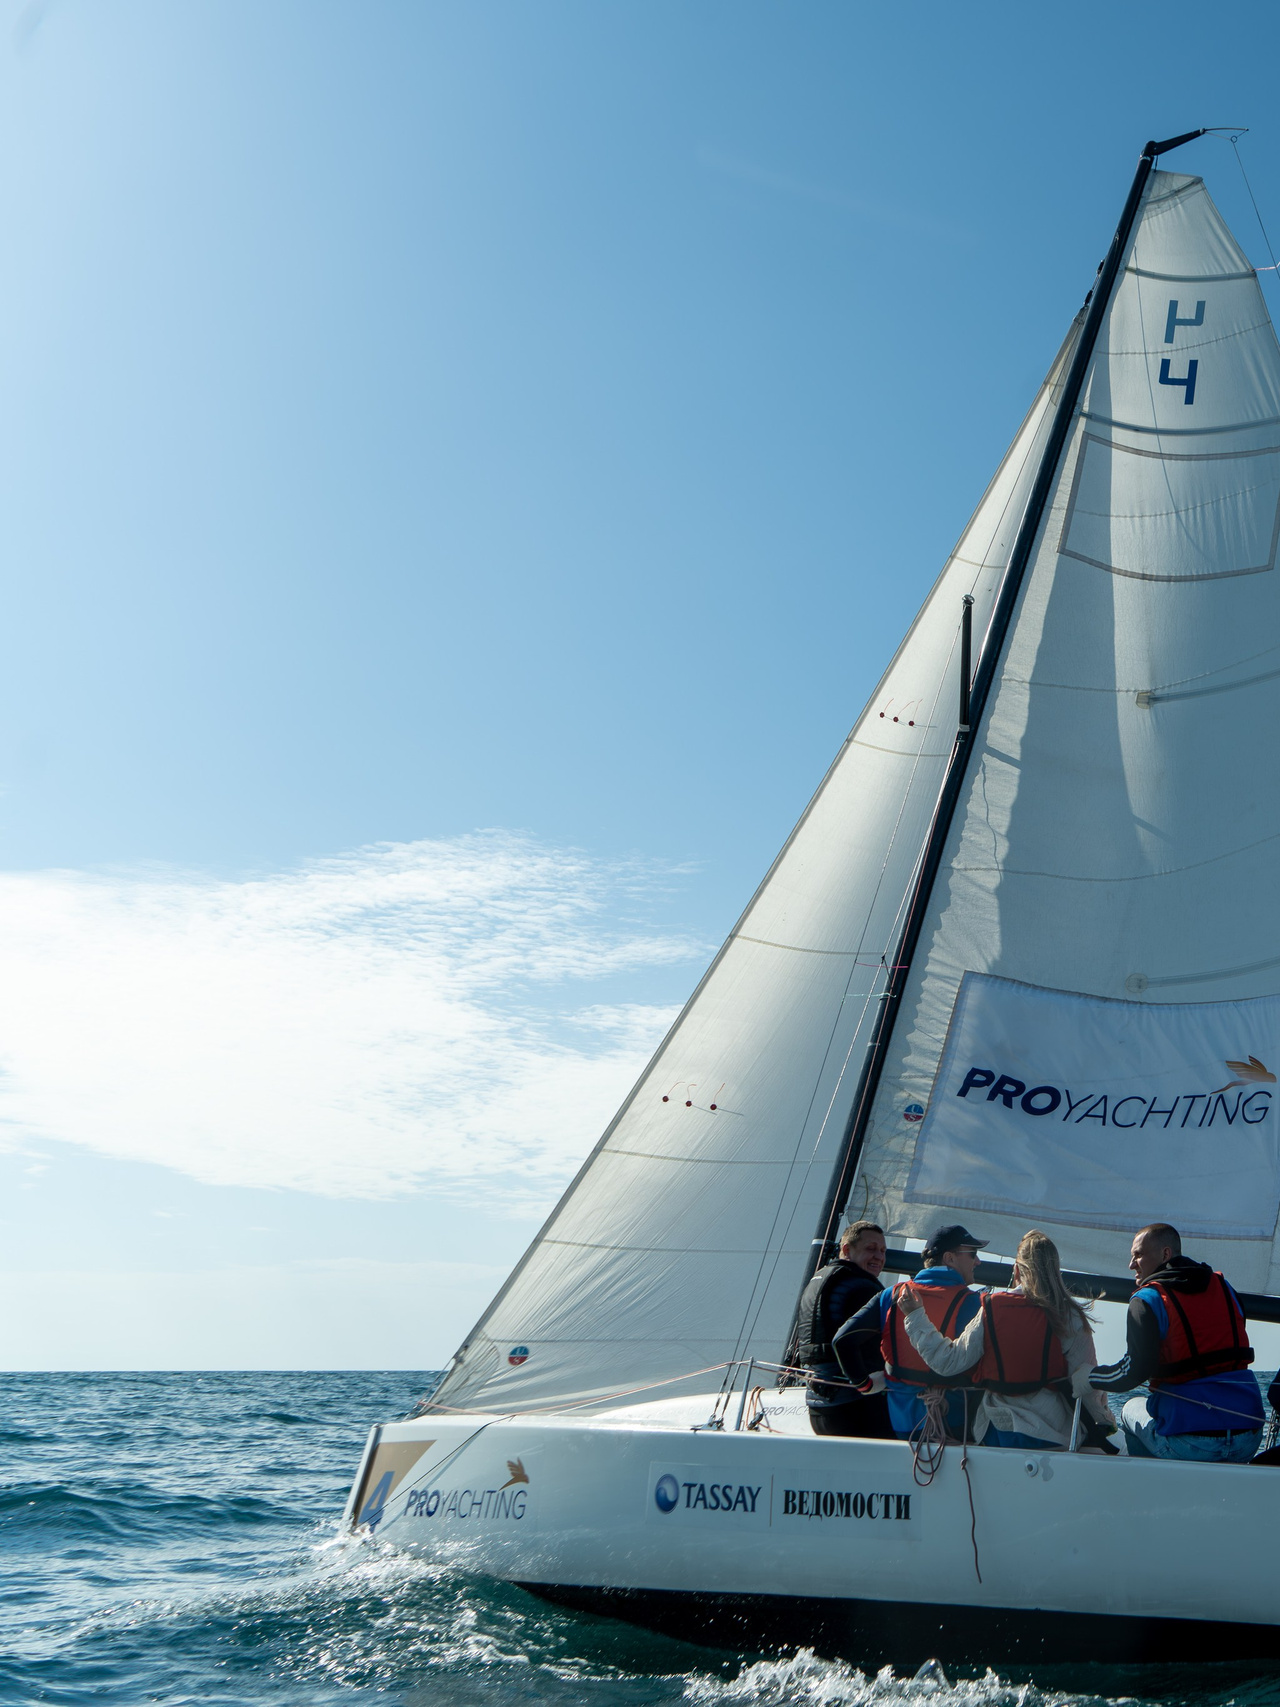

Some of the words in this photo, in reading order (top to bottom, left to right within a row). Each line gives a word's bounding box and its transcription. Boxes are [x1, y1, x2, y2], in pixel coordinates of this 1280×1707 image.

[1158, 358, 1198, 405] 4
[956, 1067, 1273, 1128] PROYACHTING
[357, 1470, 396, 1534] 4
[403, 1489, 528, 1520] PROYACHTING
[682, 1482, 763, 1513] TASSAY
[783, 1489, 912, 1522] ВЕДОМОСТИ
